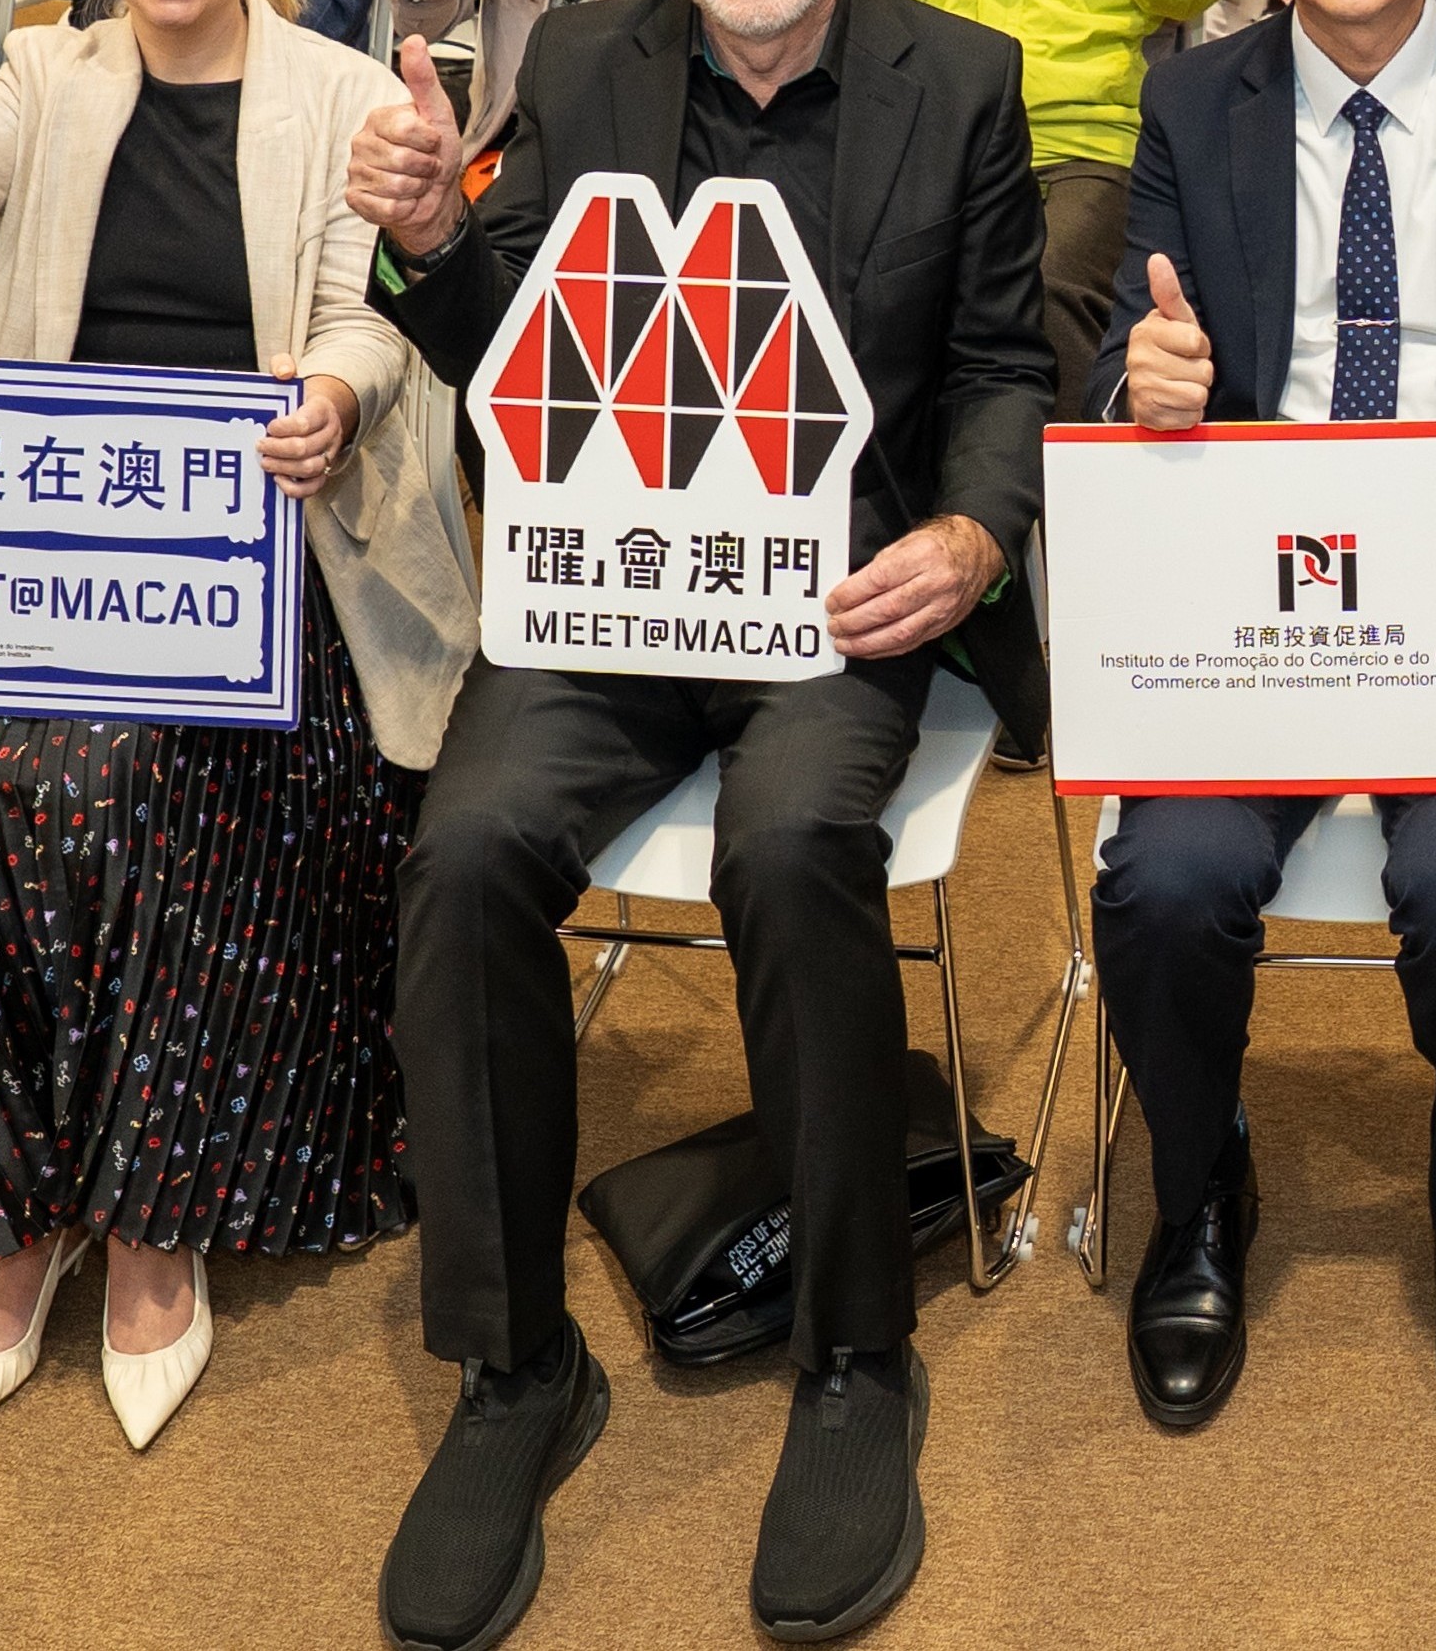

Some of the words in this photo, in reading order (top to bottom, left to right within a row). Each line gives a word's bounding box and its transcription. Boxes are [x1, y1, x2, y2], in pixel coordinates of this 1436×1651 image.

[508, 525, 820, 598] 「躍」會澳門
[525, 609, 820, 658] MEET@MACAO
[1235, 625, 1404, 648] 招商投資促進局
[1101, 654, 1164, 668] Instituto
[1170, 654, 1189, 667] de
[1196, 653, 1279, 671] Promoção
[1284, 653, 1304, 667] do
[1310, 651, 1388, 666] Comércio
[1394, 654, 1403, 665] e
[1409, 651, 1429, 665] do
[1132, 675, 1220, 689] Commerce
[1226, 675, 1255, 688] and
[1263, 675, 1350, 688] Investment
[753, 1221, 769, 1242] OF
